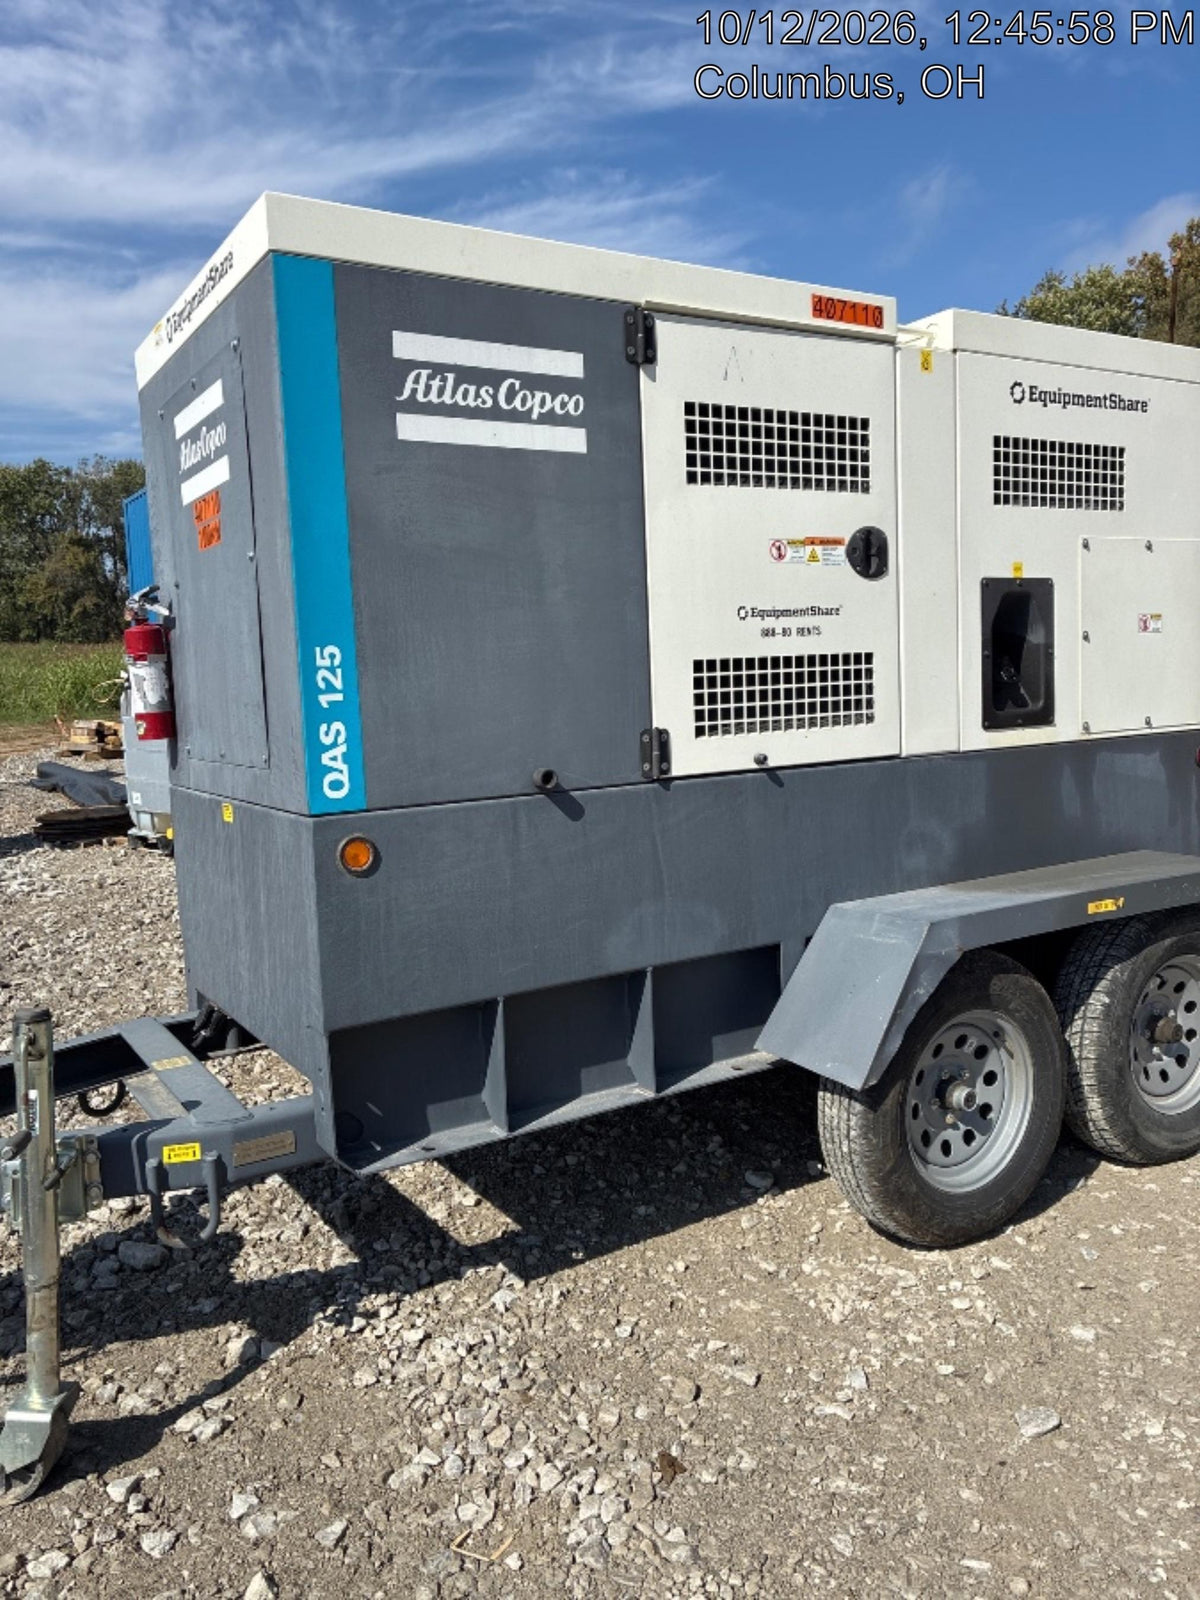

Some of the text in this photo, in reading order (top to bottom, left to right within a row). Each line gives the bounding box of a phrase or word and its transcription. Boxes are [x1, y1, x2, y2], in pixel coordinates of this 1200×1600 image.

[812, 295, 884, 328] 407110
[395, 368, 585, 421] Atlas Copco
[1028, 384, 1149, 414] EquipmentShare
[749, 604, 841, 621] EquipmentShare
[796, 624, 822, 637] RENTS
[315, 644, 351, 800] QAS 125
